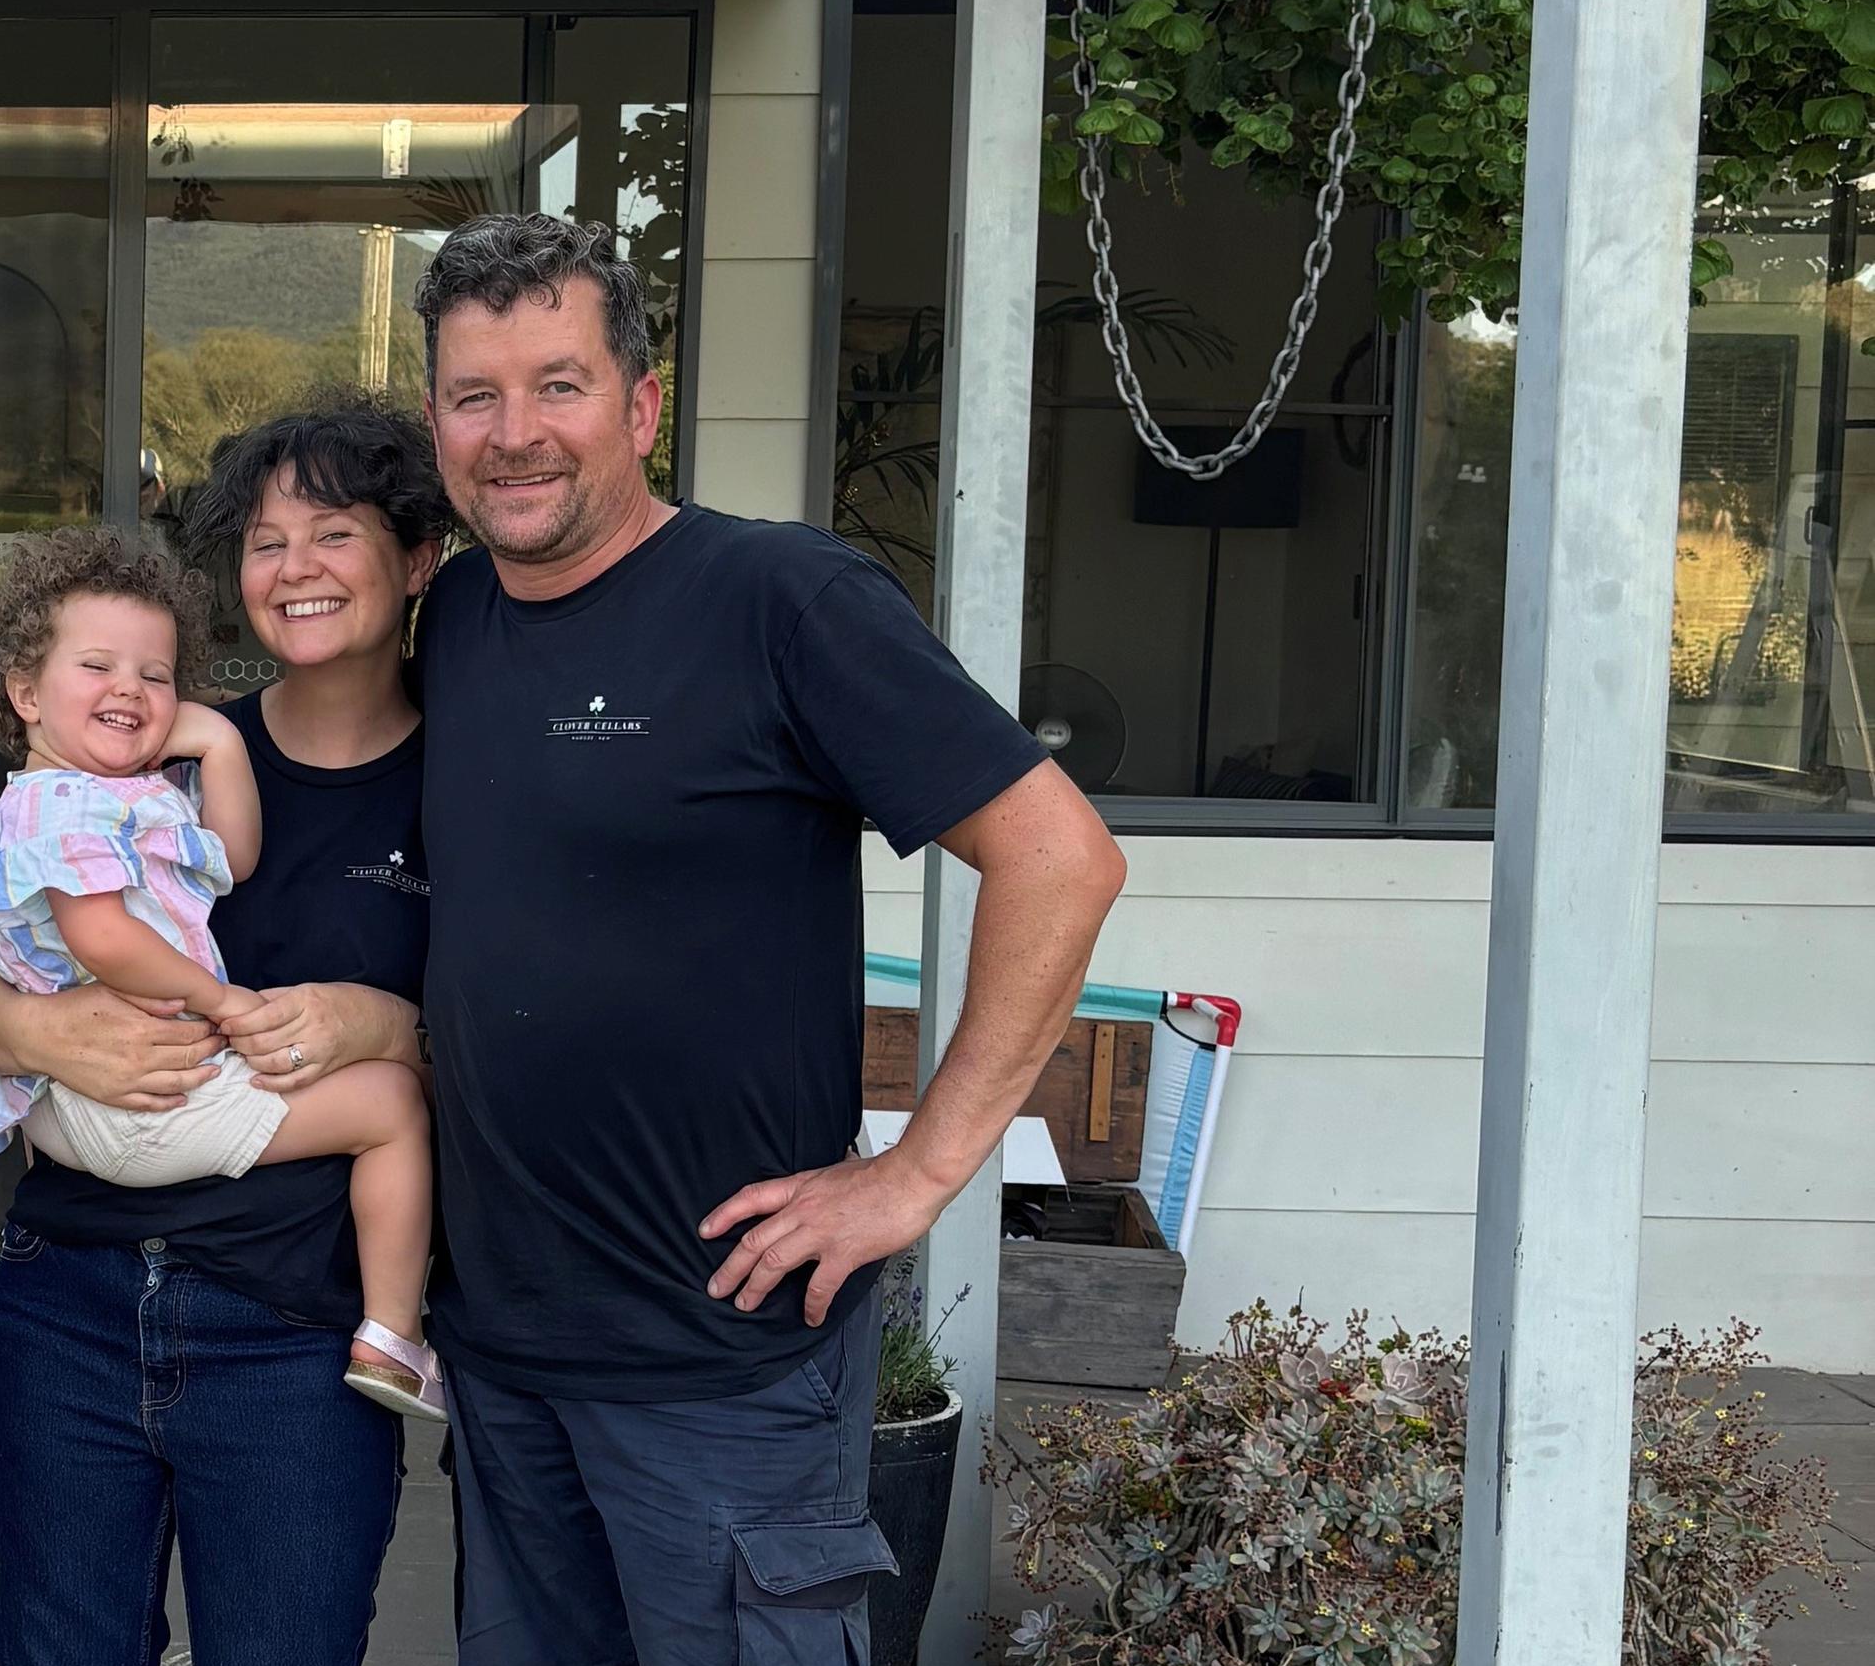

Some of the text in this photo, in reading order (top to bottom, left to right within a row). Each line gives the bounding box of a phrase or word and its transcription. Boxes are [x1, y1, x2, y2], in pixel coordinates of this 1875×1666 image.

[552, 721, 641, 731] CLOVER CELLARS
[395, 873, 431, 893] CELLAR
